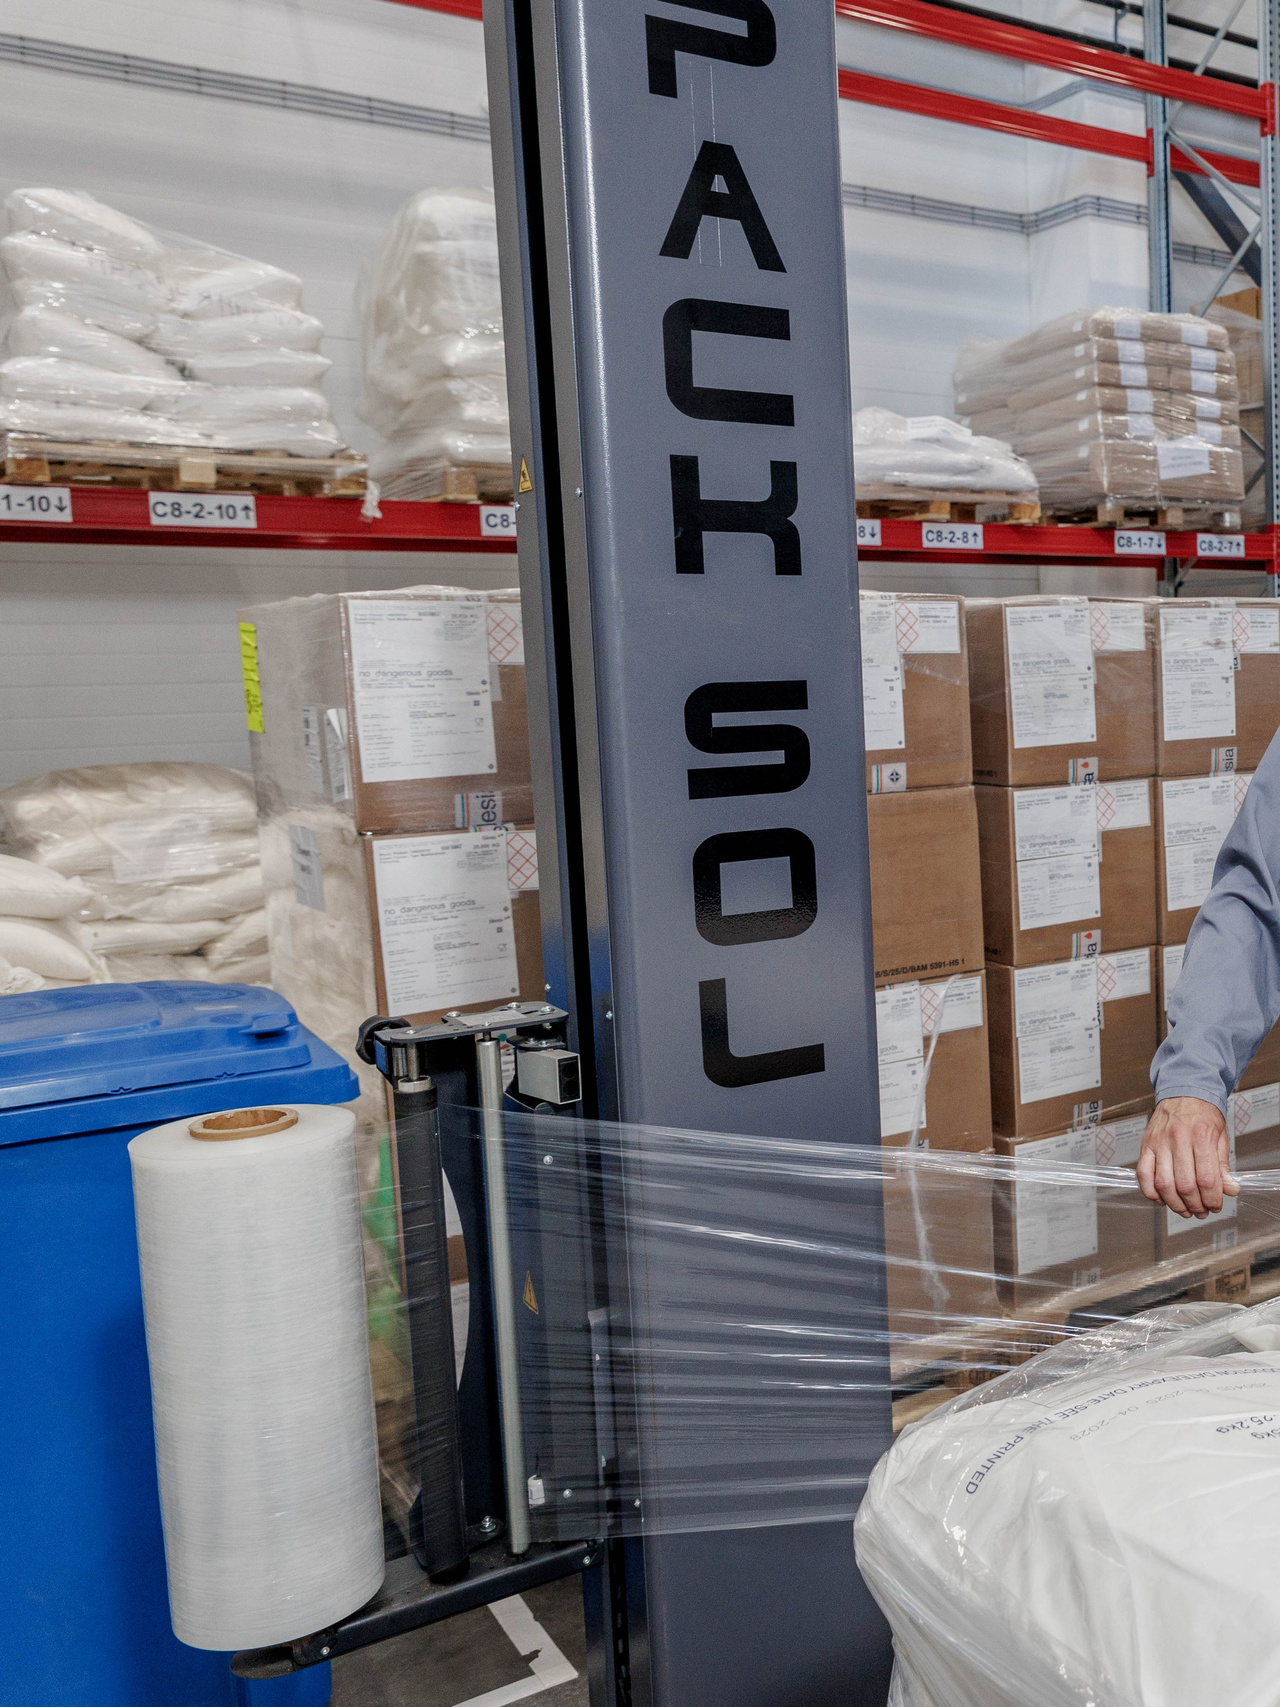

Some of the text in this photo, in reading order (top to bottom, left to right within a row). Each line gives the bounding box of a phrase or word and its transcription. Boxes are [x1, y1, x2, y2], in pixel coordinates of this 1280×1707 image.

[152, 501, 237, 519] C8-2-10
[645, 0, 826, 1088] PACK SOL
[925, 530, 969, 543] C8-2-8
[1117, 536, 1154, 548] C8-1-7
[1200, 540, 1233, 552] C8-2-7
[376, 669, 422, 679] dangerous
[427, 669, 453, 679] goods
[401, 902, 446, 915] dangerous
[450, 899, 476, 910] goods
[1022, 1416, 1051, 1434] THE
[965, 1435, 1024, 1495] PRINTED
